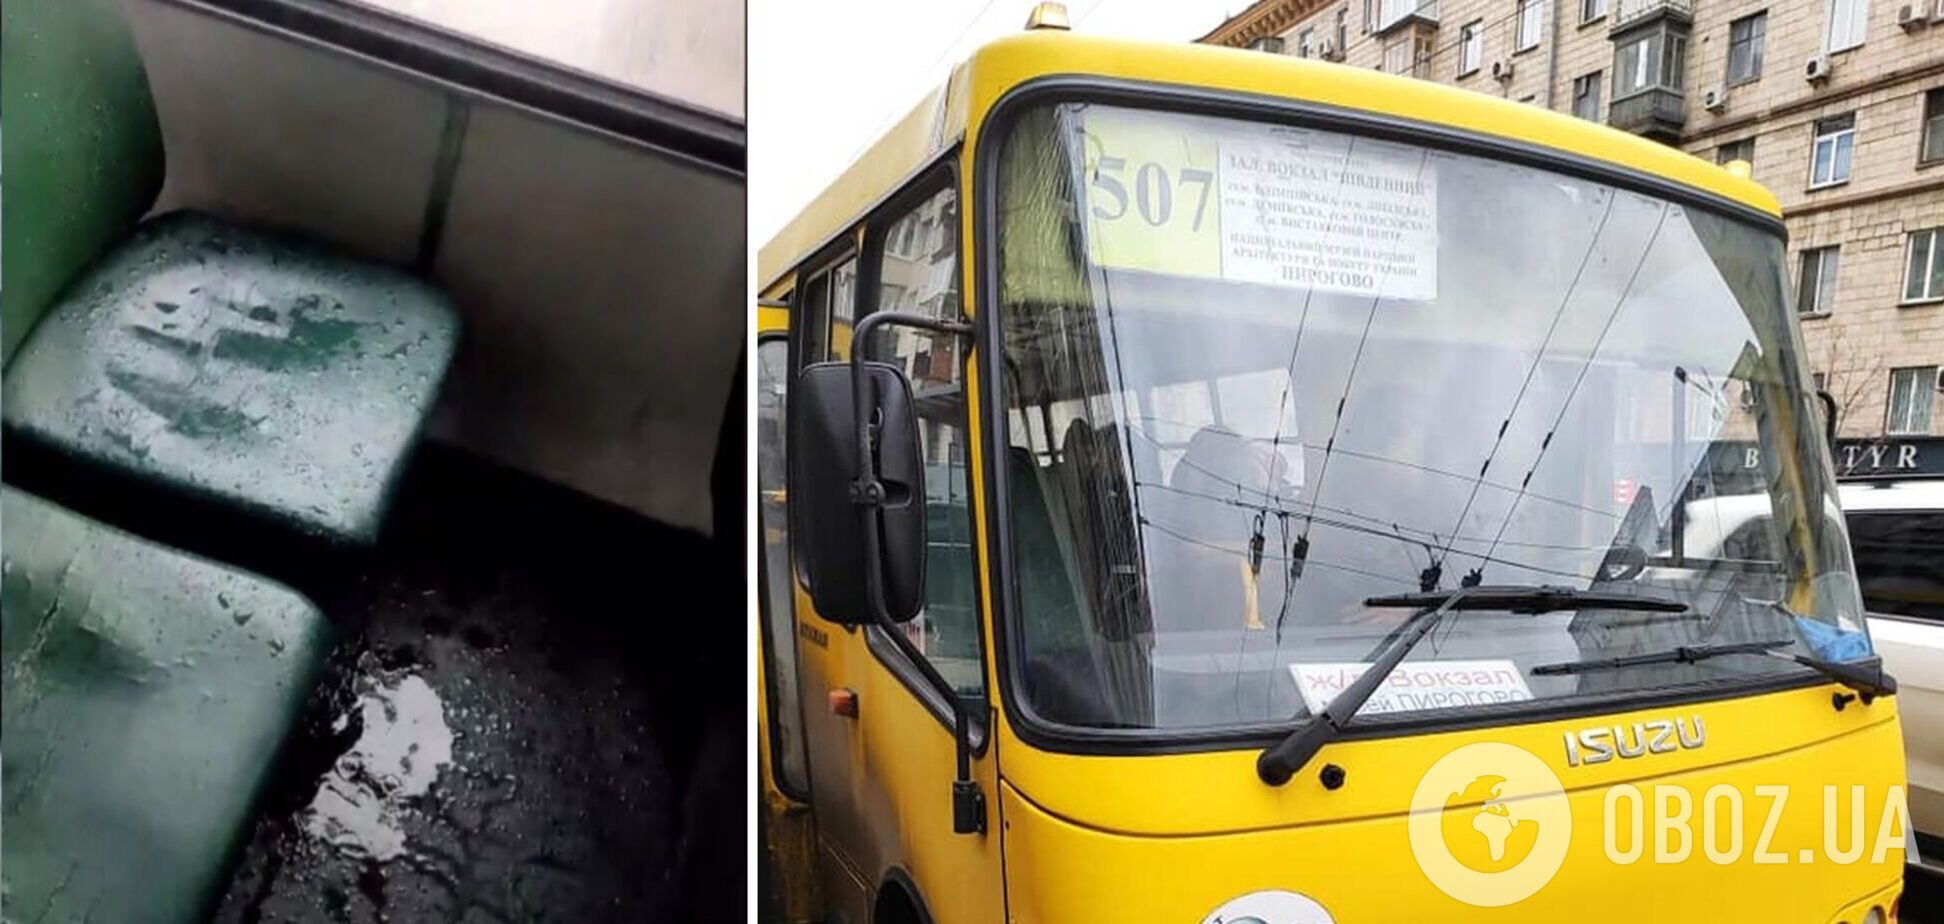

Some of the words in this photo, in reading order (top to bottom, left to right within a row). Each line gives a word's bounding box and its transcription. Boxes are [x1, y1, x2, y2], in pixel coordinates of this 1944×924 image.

[1267, 161, 1327, 181] ВОКЗАЛ
[1091, 156, 1214, 233] 507
[1281, 264, 1373, 289] ПИРОГОВО
[1389, 669, 1517, 688] Вокзал
[1563, 716, 1707, 767] ISUZU
